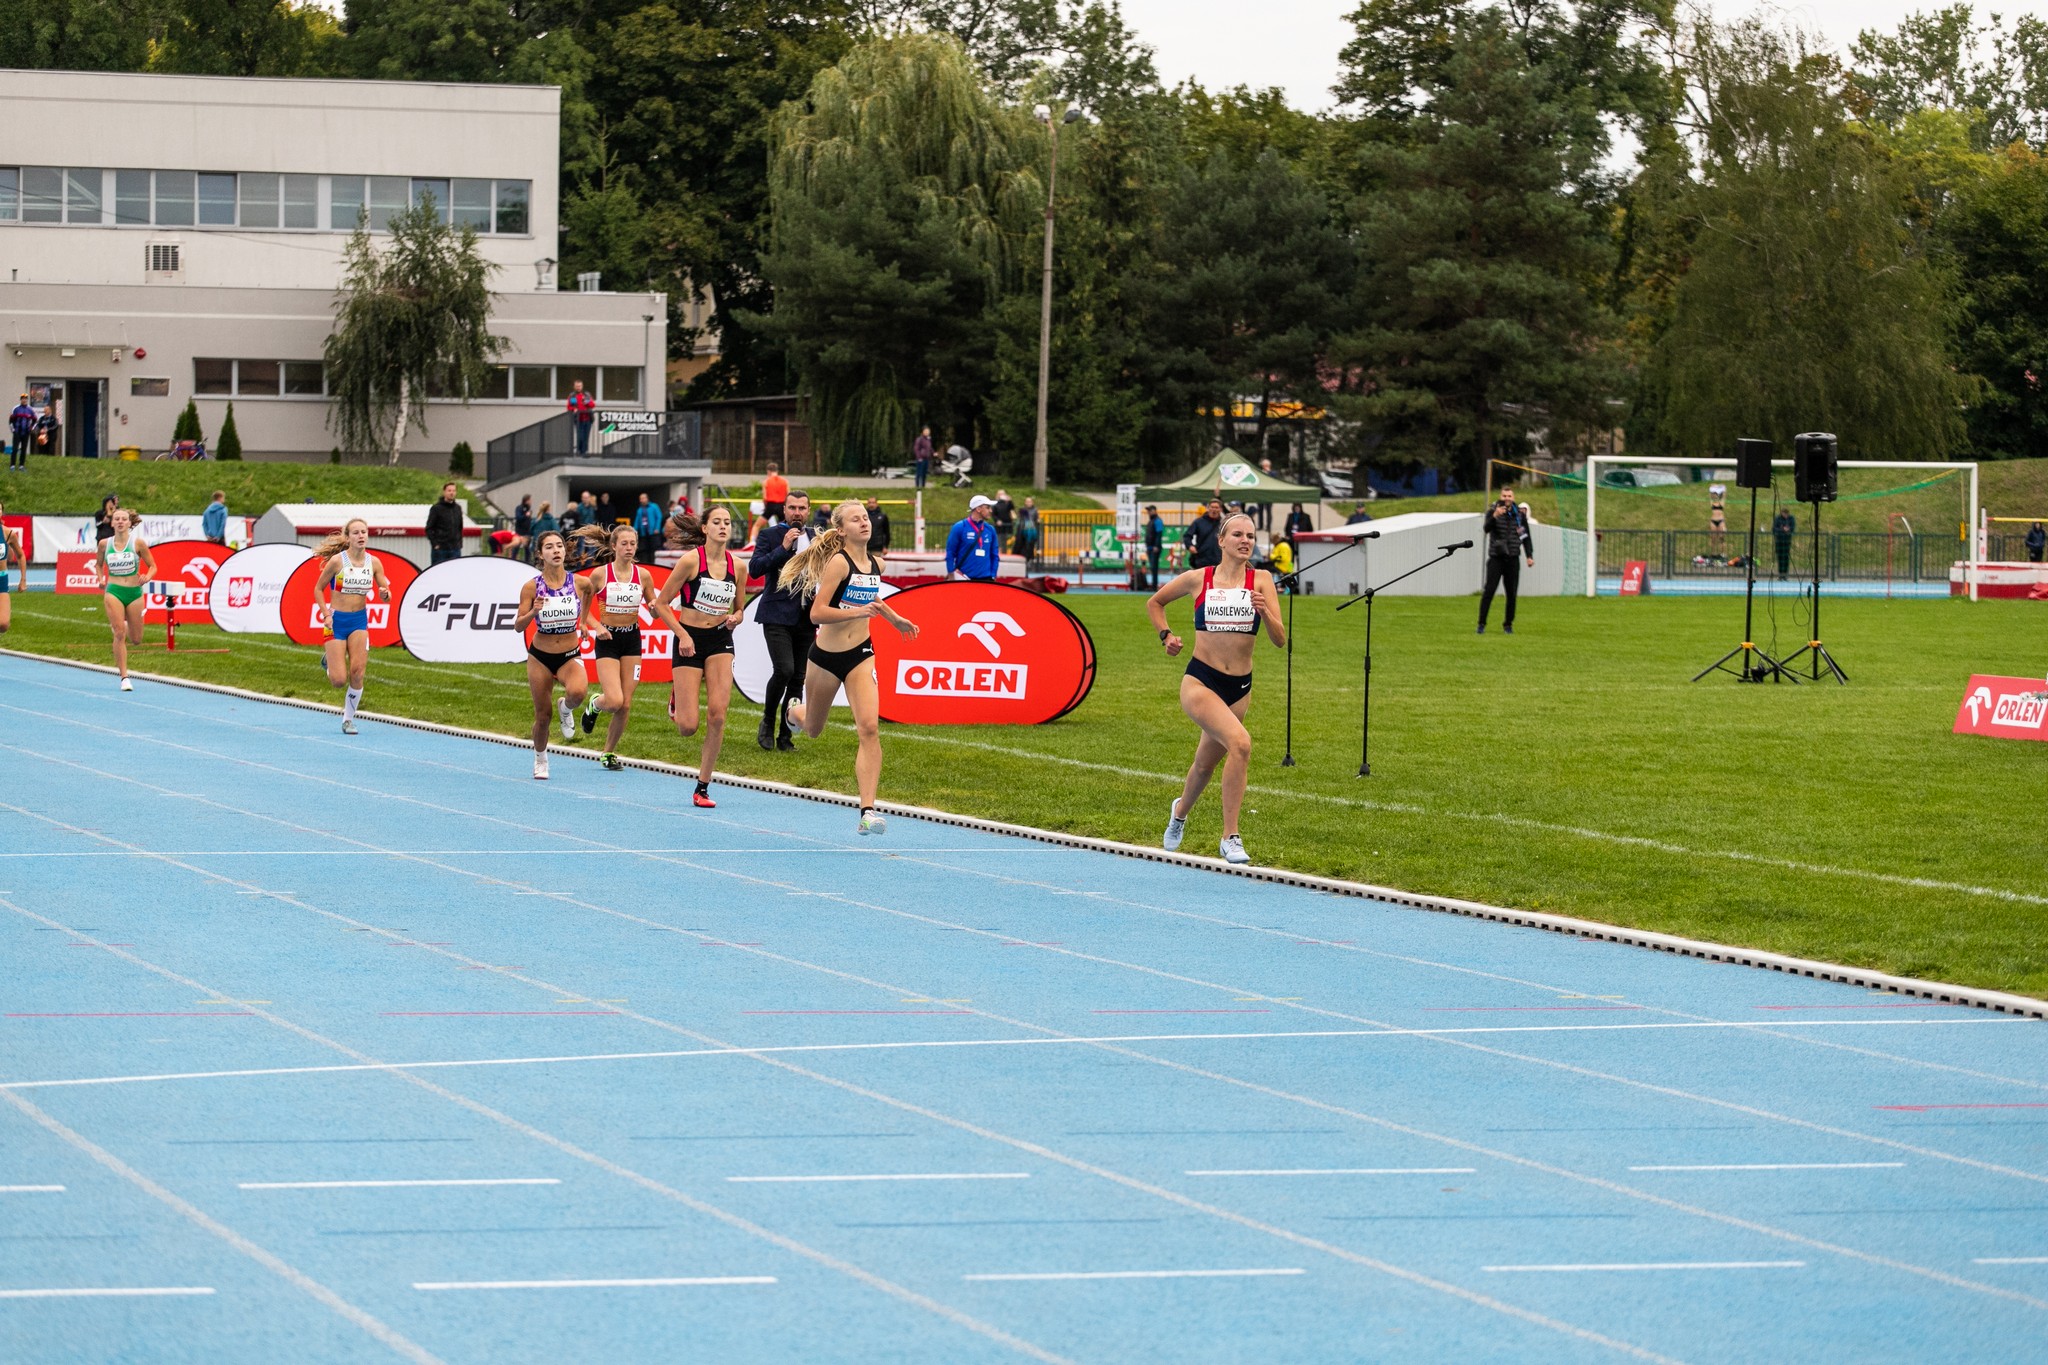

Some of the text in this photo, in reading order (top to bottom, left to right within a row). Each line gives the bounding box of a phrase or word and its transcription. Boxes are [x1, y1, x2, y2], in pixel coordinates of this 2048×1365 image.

[600, 411, 657, 423] STRZELNICA
[617, 422, 658, 431] SPORTOWA
[868, 577, 877, 586] 12
[724, 583, 734, 593] 31
[616, 595, 634, 603] HOC
[701, 591, 731, 604] MUCHA
[1240, 590, 1247, 600] 7
[542, 608, 575, 618] RUDNIK
[1207, 606, 1254, 617] WASILEWSKA
[904, 665, 1018, 693] ORLEN
[1997, 699, 2043, 723] ORLEN
